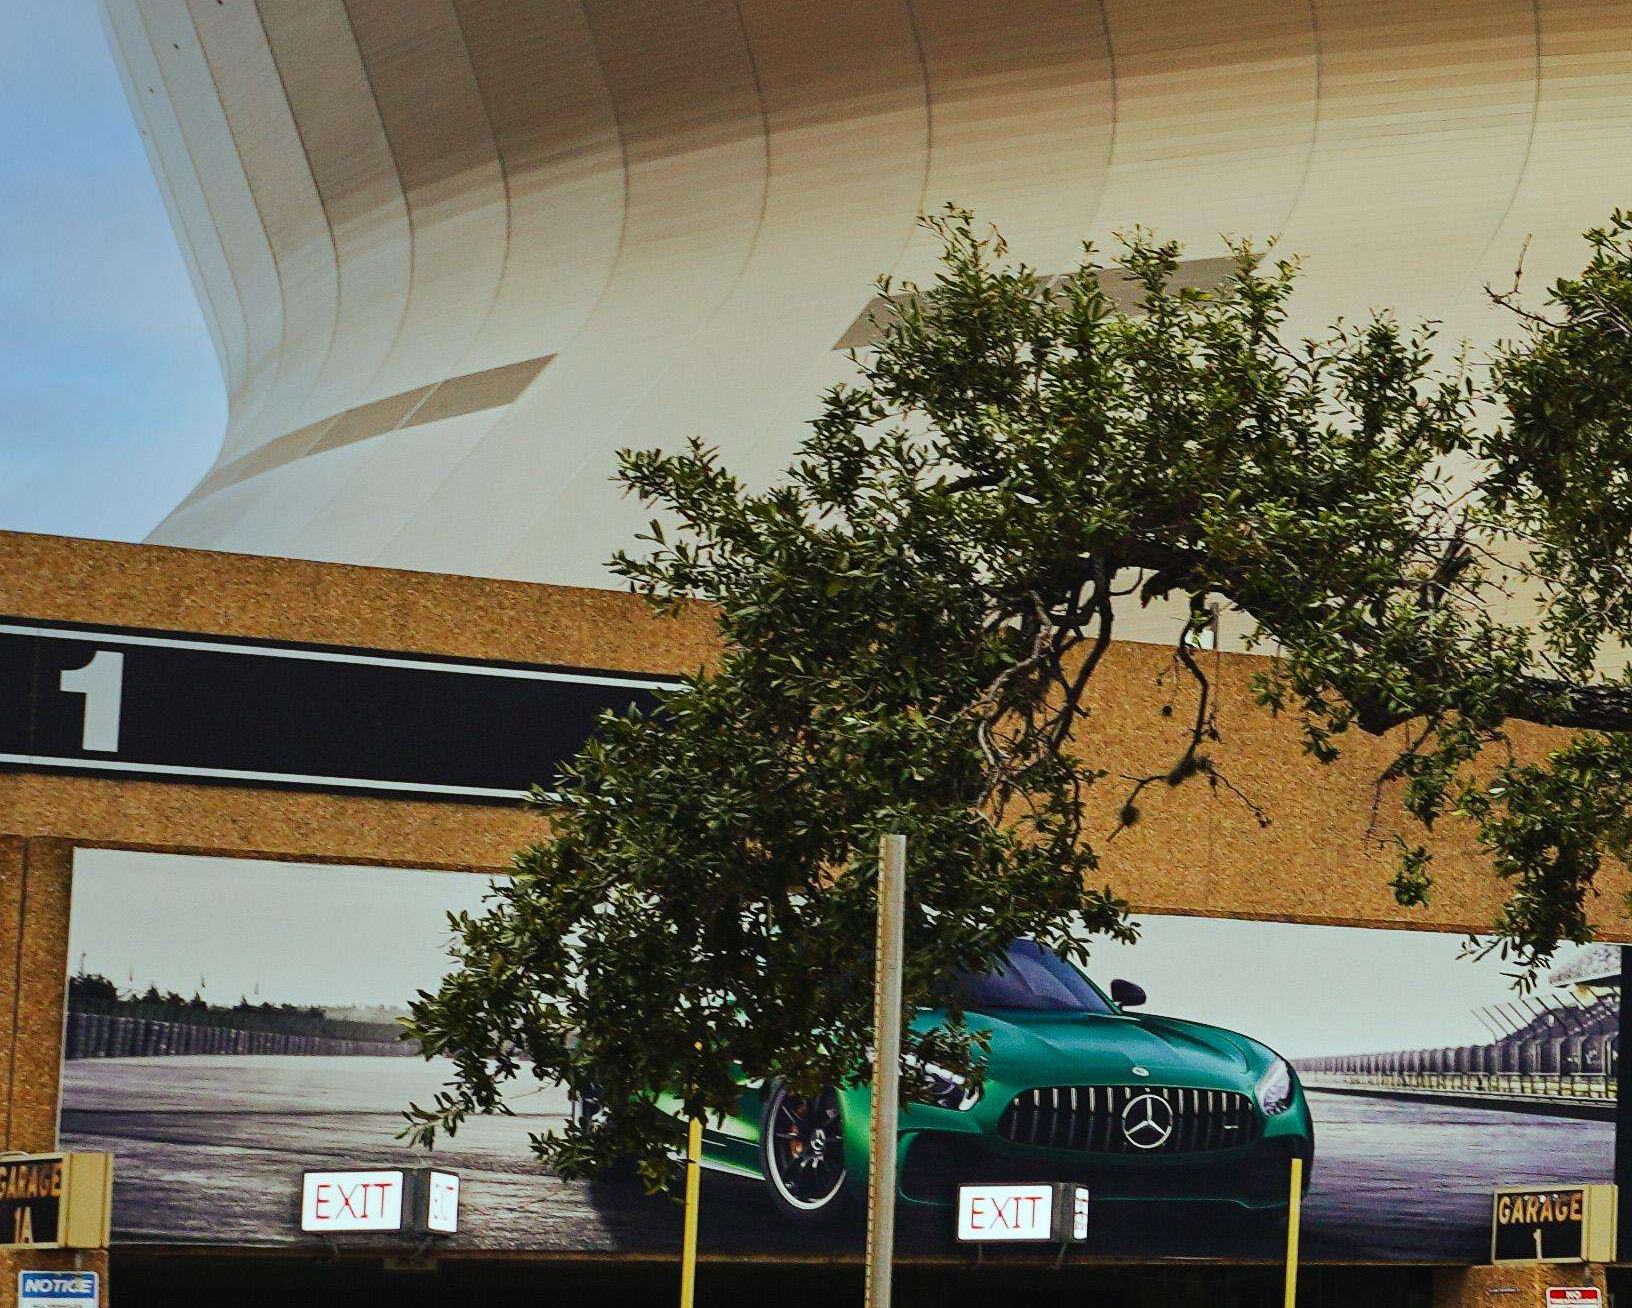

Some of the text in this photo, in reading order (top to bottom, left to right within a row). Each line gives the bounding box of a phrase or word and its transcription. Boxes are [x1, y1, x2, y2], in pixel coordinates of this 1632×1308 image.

[60, 650, 124, 752] 1
[315, 1183, 393, 1219] EXIT
[971, 1197, 1042, 1229] EXIT
[1499, 1193, 1583, 1224] GARAGE
[1533, 1228, 1543, 1260] 1
[24, 1279, 93, 1293] NOTICE
